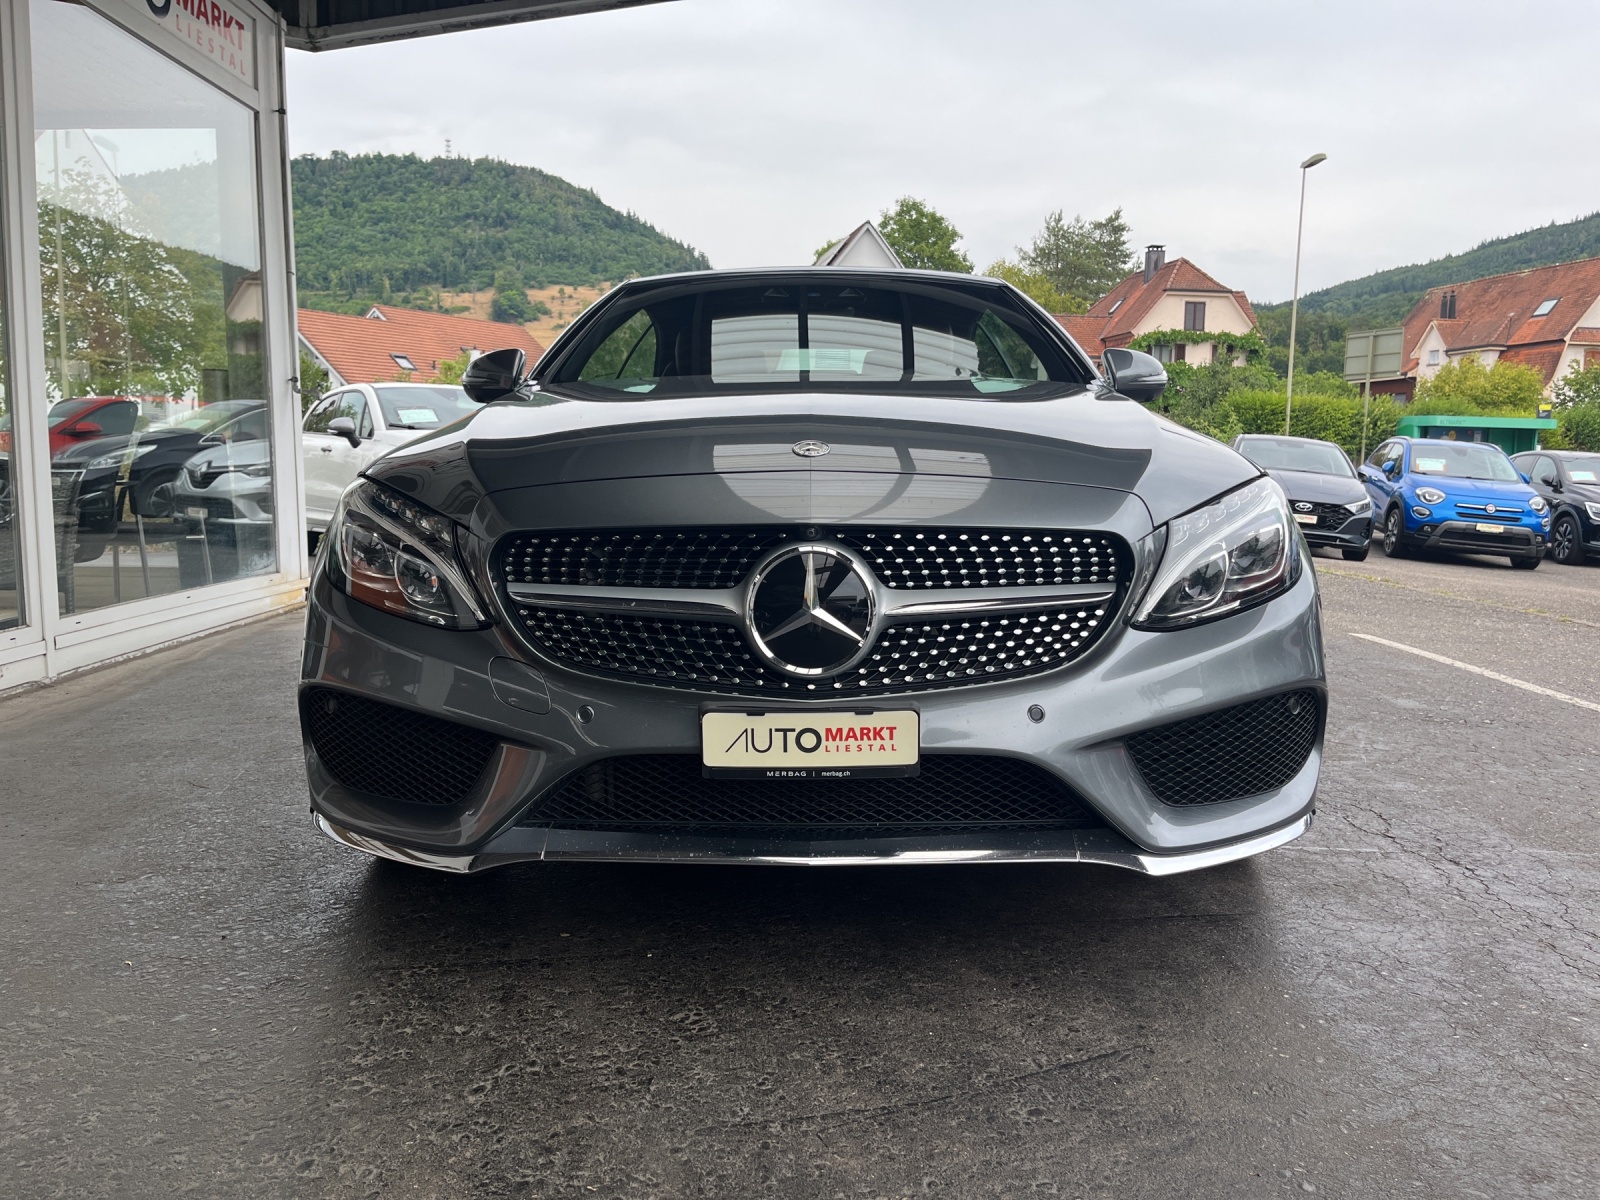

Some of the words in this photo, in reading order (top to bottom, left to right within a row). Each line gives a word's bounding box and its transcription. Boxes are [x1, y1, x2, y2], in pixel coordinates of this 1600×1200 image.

[176, 13, 246, 76] LIESTAL
[725, 727, 822, 753] AUTO
[825, 726, 897, 742] MARKT
[825, 744, 897, 753] LIESTAL
[821, 770, 851, 778] merbag.ch
